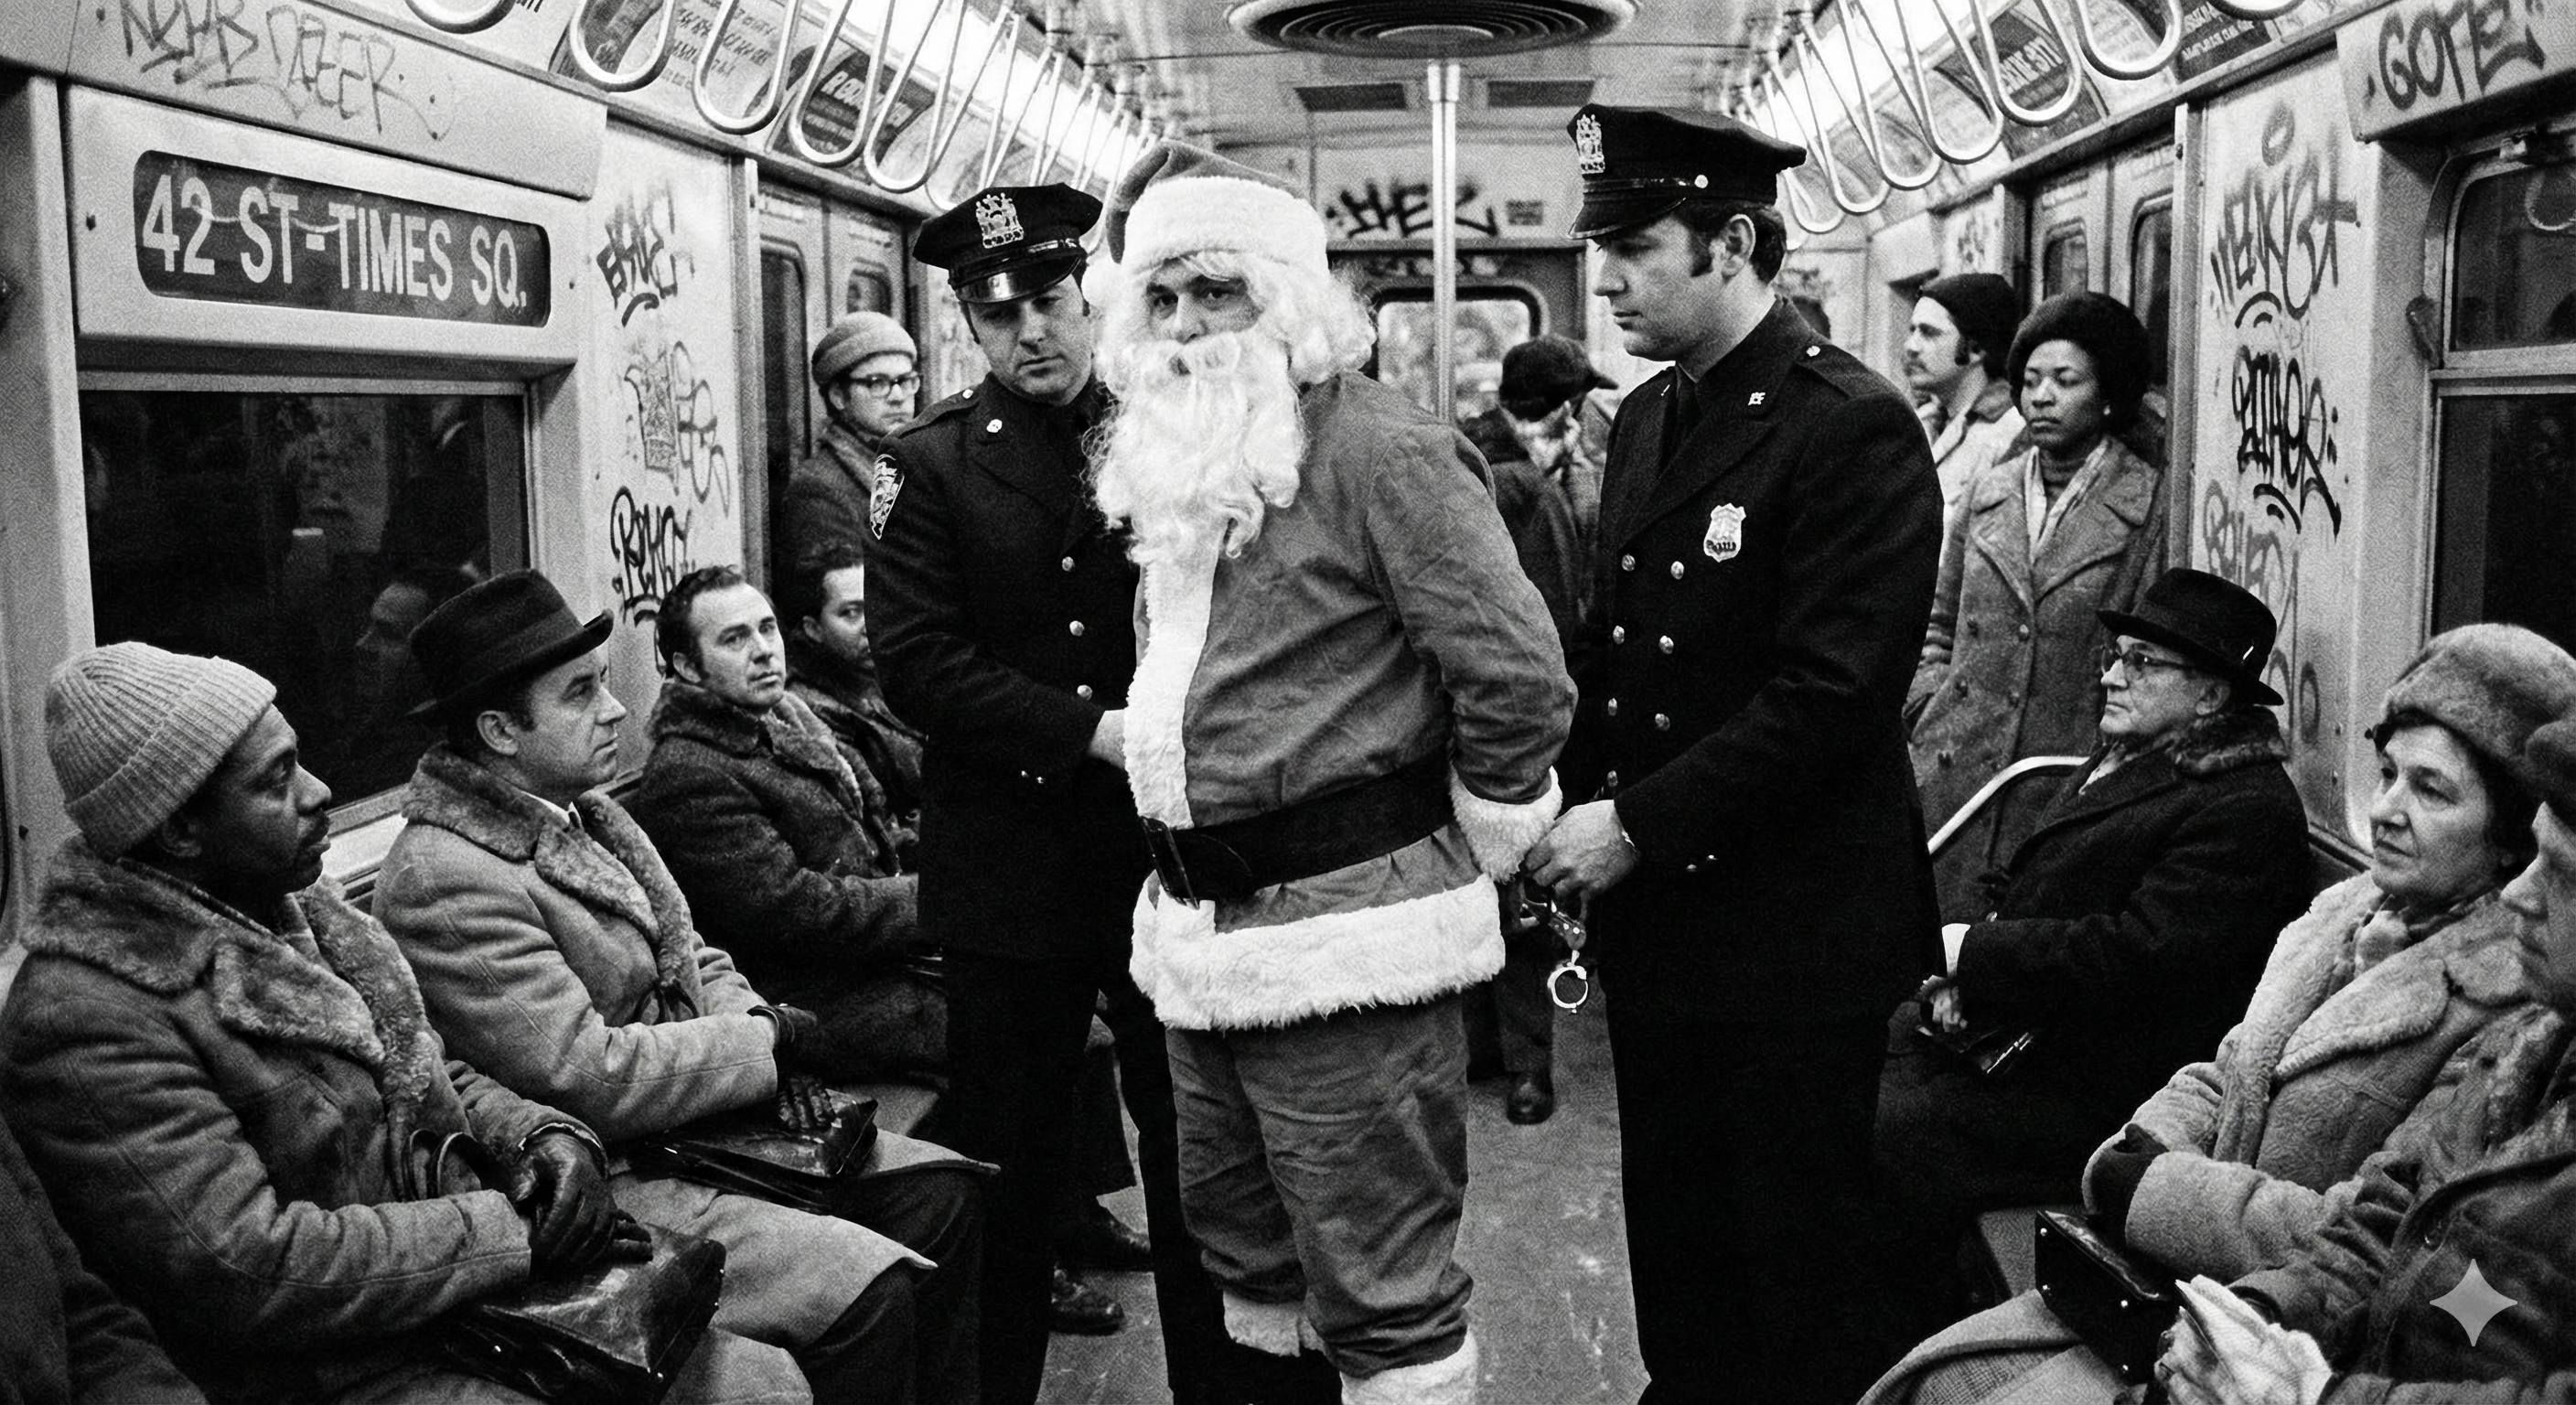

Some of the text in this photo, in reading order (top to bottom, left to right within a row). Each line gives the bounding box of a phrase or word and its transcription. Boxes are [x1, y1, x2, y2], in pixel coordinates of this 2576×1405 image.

[143, 174, 215, 274] 42
[239, 186, 453, 301] ST-TIMES
[470, 225, 529, 309] SQ.
